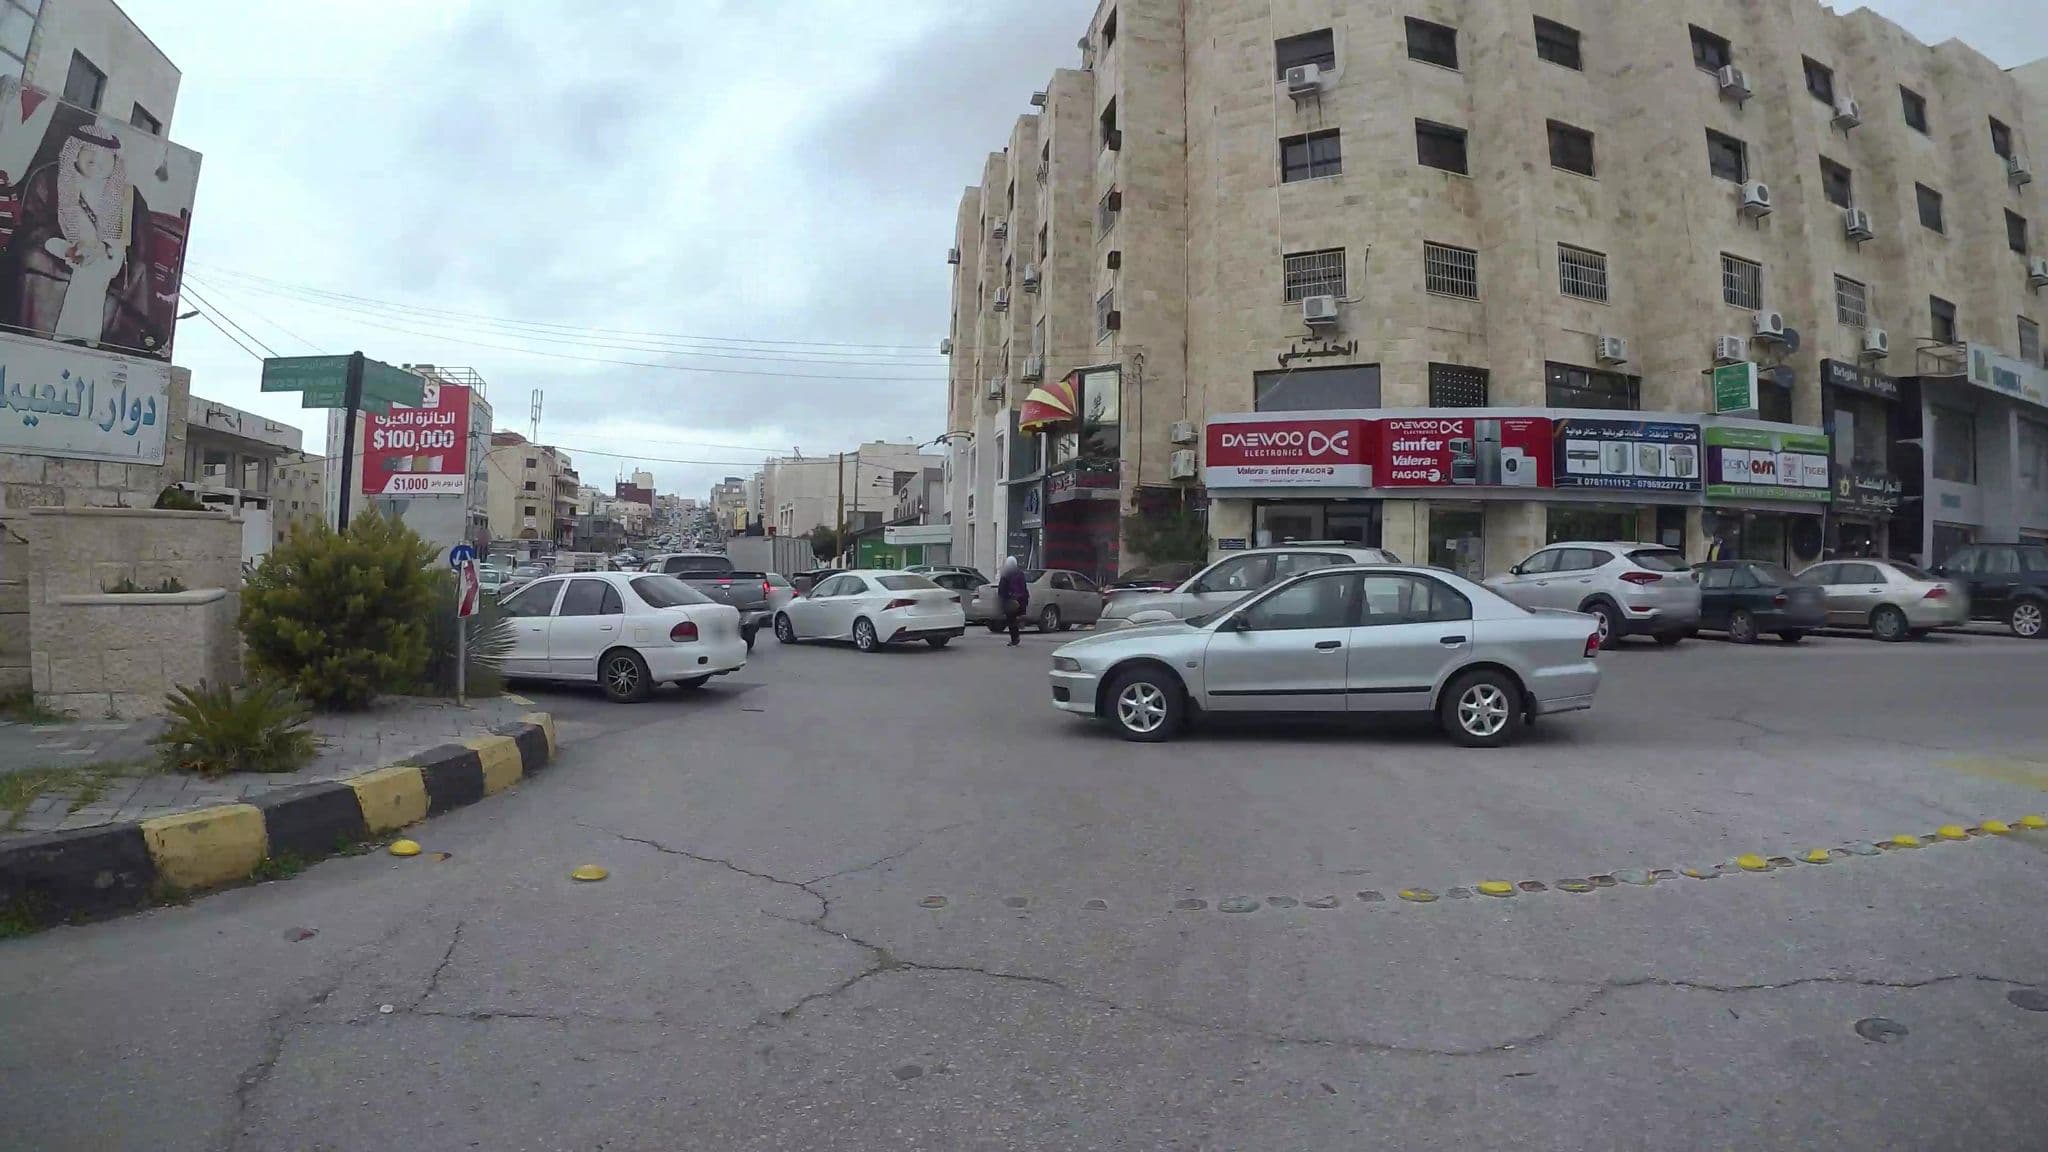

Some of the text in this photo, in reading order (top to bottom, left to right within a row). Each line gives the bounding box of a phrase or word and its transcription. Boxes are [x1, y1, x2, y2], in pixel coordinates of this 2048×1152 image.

[99, 384, 156, 435] دوار
[375, 411, 455, 428] الجائزة الكبرى
[1390, 421, 1438, 430] DAEWOO
[373, 427, 455, 451] $100,000
[1222, 431, 1304, 447] DAEWOO
[1392, 437, 1443, 452] simfer
[1244, 449, 1303, 457] ELECTRONICS
[1392, 455, 1431, 466] Valera
[1237, 467, 1263, 475] Valera
[1271, 467, 1300, 475] simfer
[1392, 470, 1427, 479] FAGOR
[394, 478, 428, 491] $1,000
